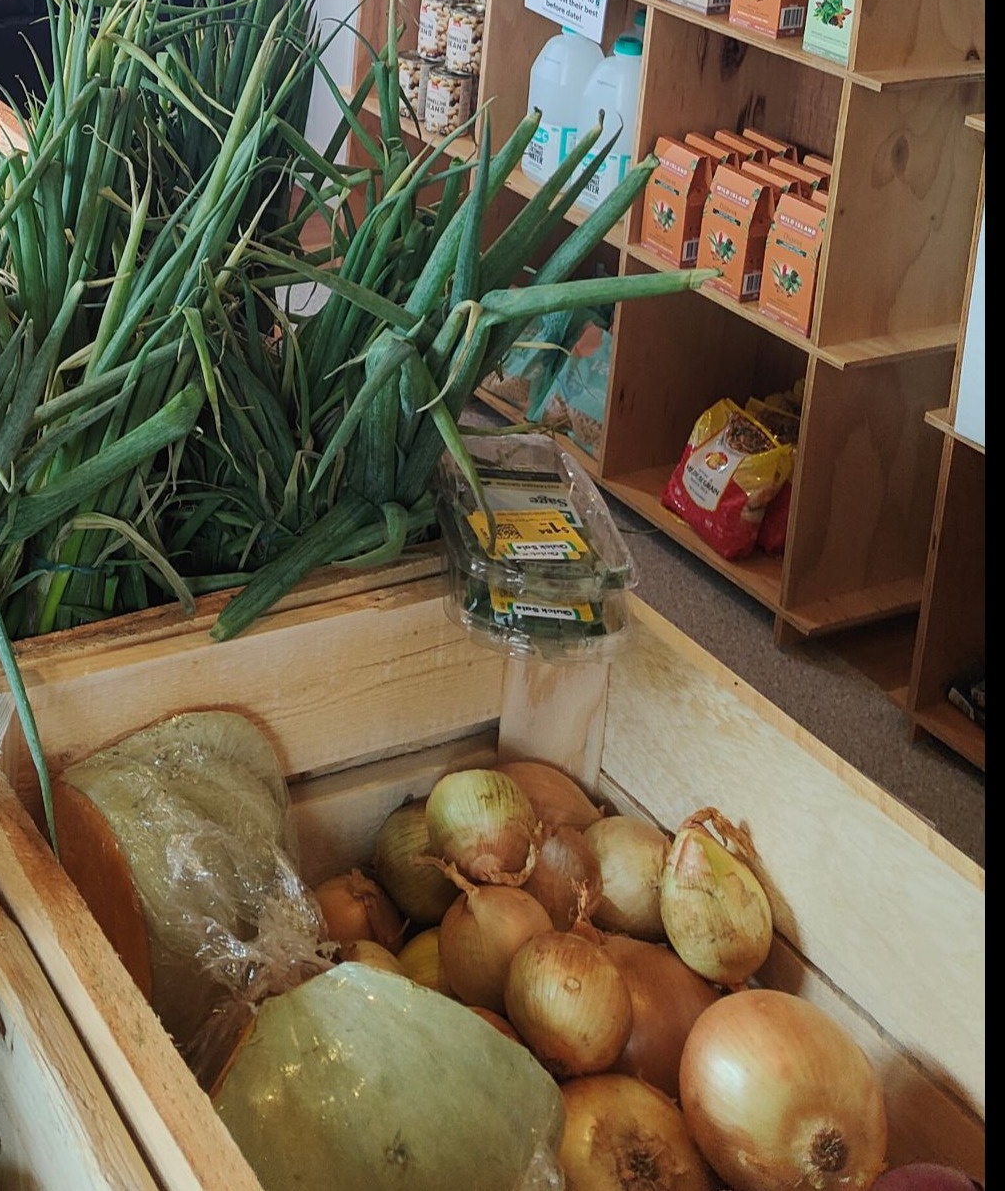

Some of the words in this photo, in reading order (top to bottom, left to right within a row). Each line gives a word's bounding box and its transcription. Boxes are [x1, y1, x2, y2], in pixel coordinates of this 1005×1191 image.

[546, 0, 565, 14] before
[566, 9, 582, 22] date!
[585, 5, 598, 18] best
[586, 182, 600, 195] ATER
[717, 185, 729, 196] WILD
[730, 191, 750, 205] ISLAND
[780, 214, 795, 226] WILD
[795, 220, 816, 236] ISLAND
[529, 494, 568, 508] Sage
[515, 543, 539, 551] Sale
[541, 543, 568, 551] Quick
[515, 604, 540, 614] Sale
[542, 606, 573, 617] Quick
